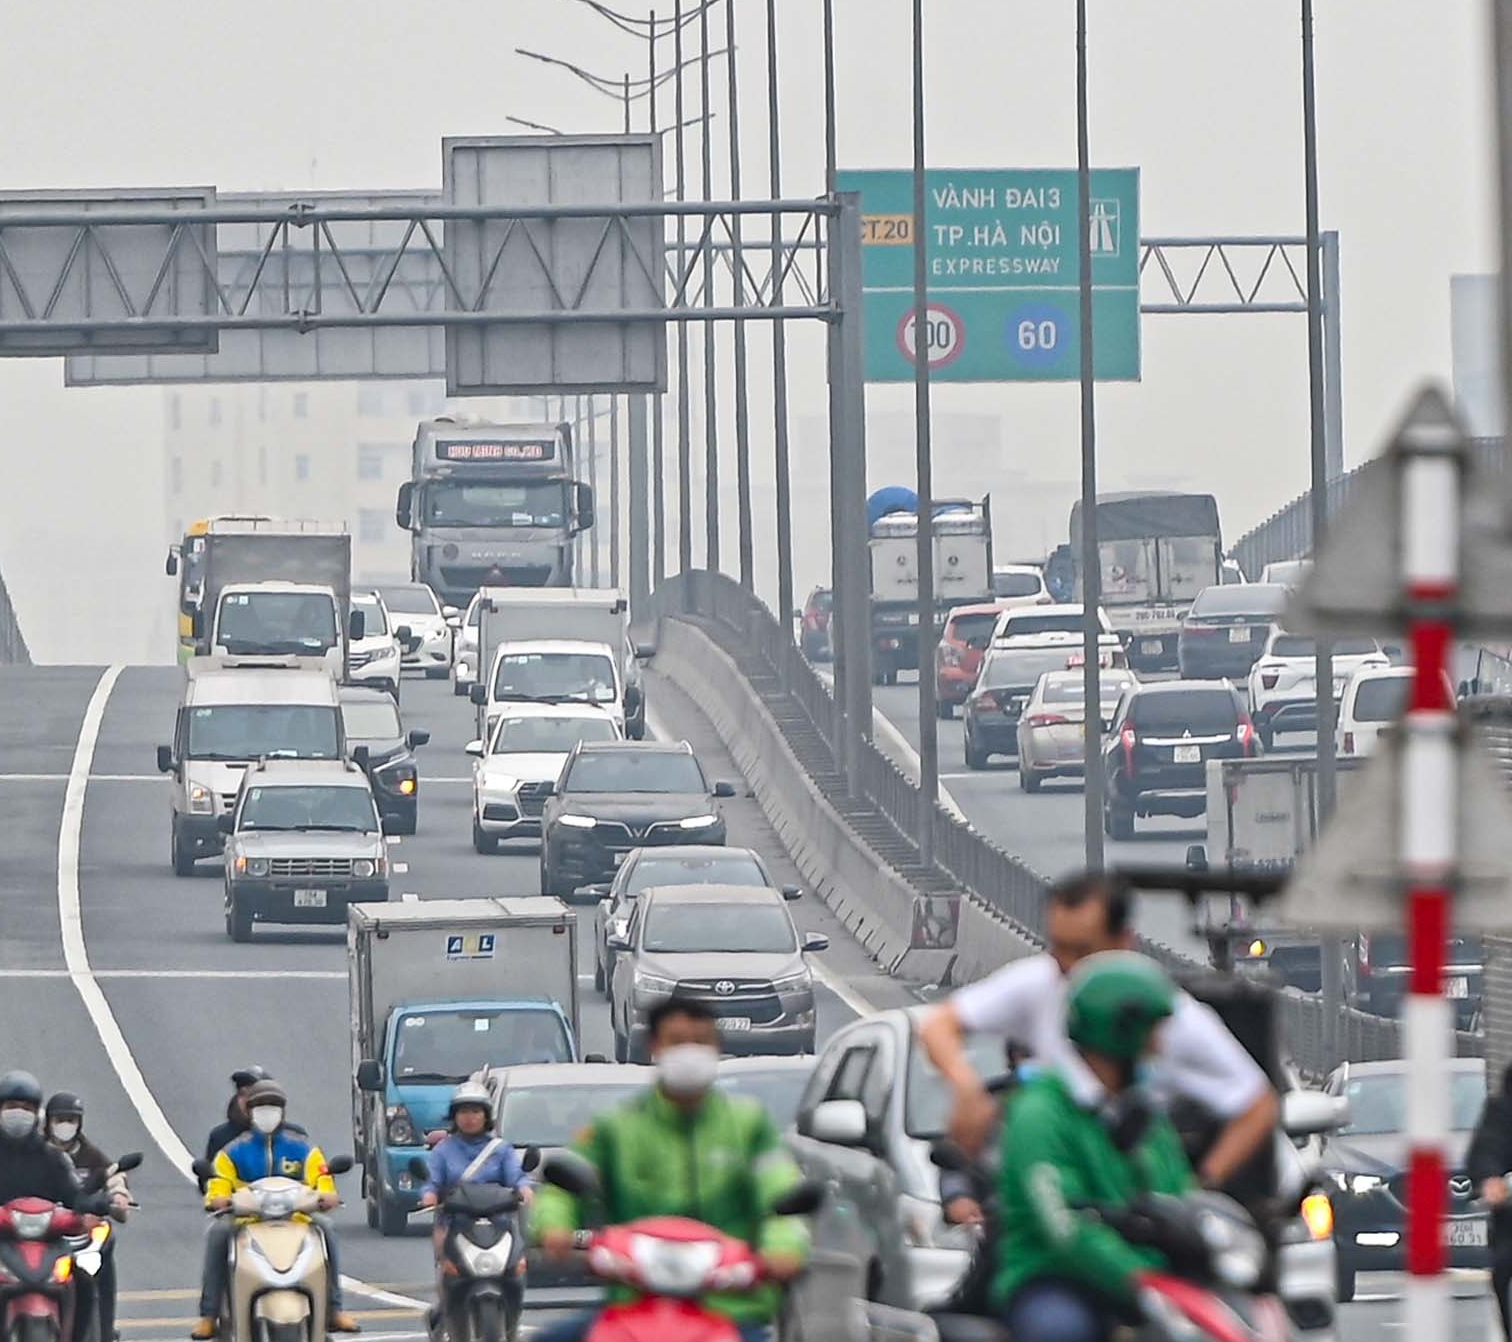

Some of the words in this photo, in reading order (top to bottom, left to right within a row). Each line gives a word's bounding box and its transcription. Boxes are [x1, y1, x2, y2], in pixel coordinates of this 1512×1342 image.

[932, 182, 995, 209] VÀNH
[1020, 220, 1060, 250] NỘI
[932, 257, 1060, 275] EXPRESSWAY
[911, 321, 950, 349] 00
[1018, 321, 1057, 349] 60
